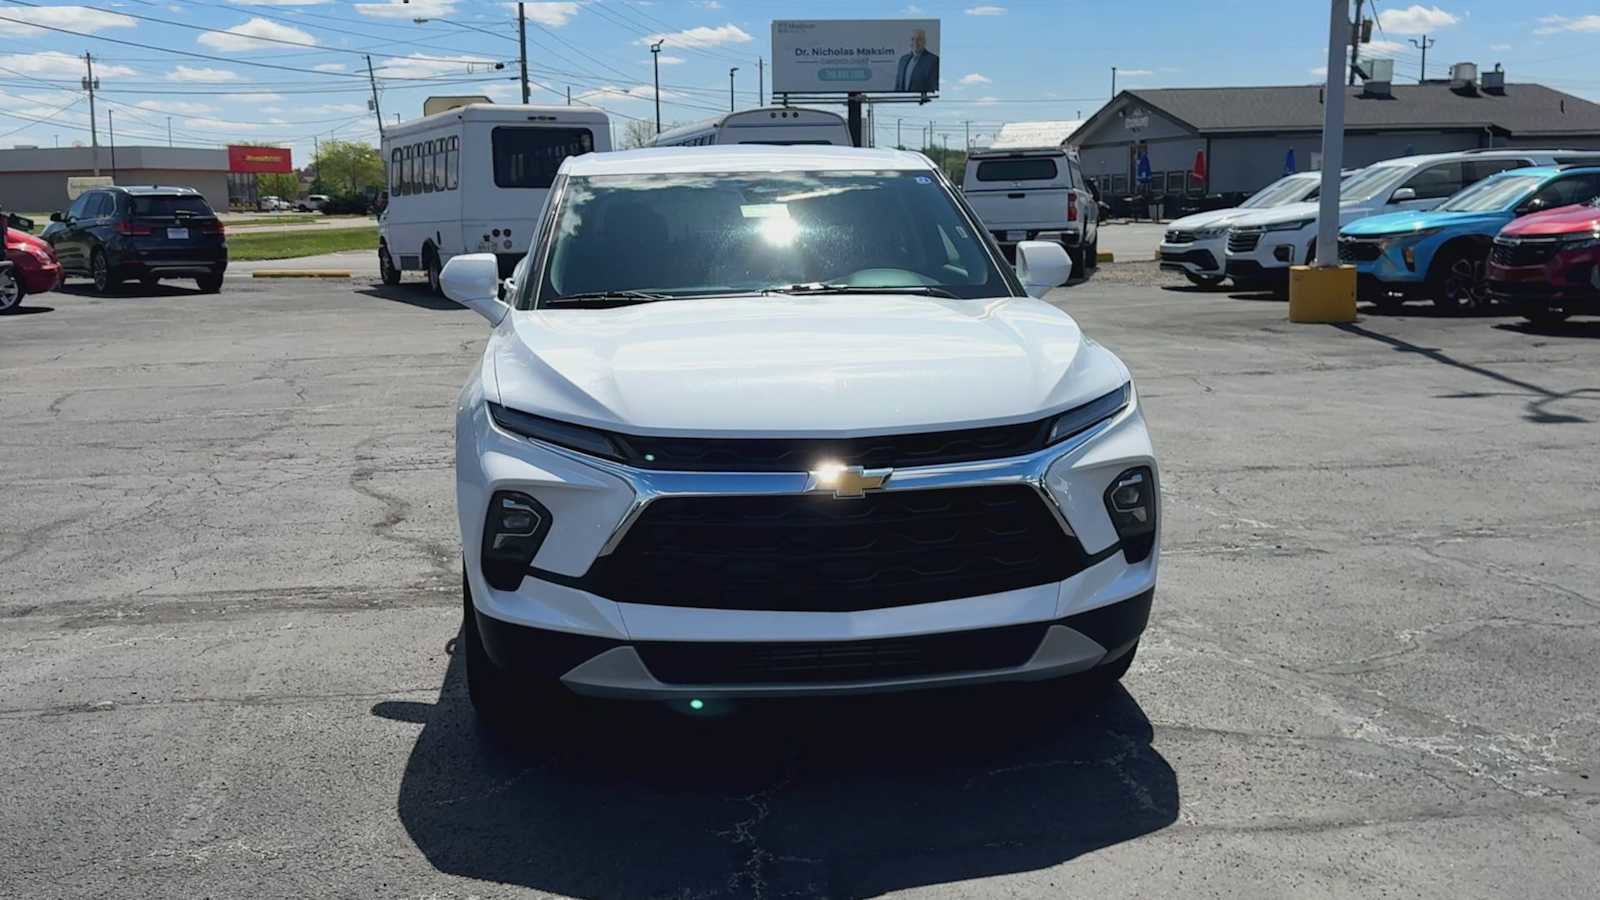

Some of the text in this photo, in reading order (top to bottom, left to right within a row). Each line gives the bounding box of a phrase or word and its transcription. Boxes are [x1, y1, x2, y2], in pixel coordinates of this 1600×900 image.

[795, 47, 896, 57] Dr. Nicholas Maksim
